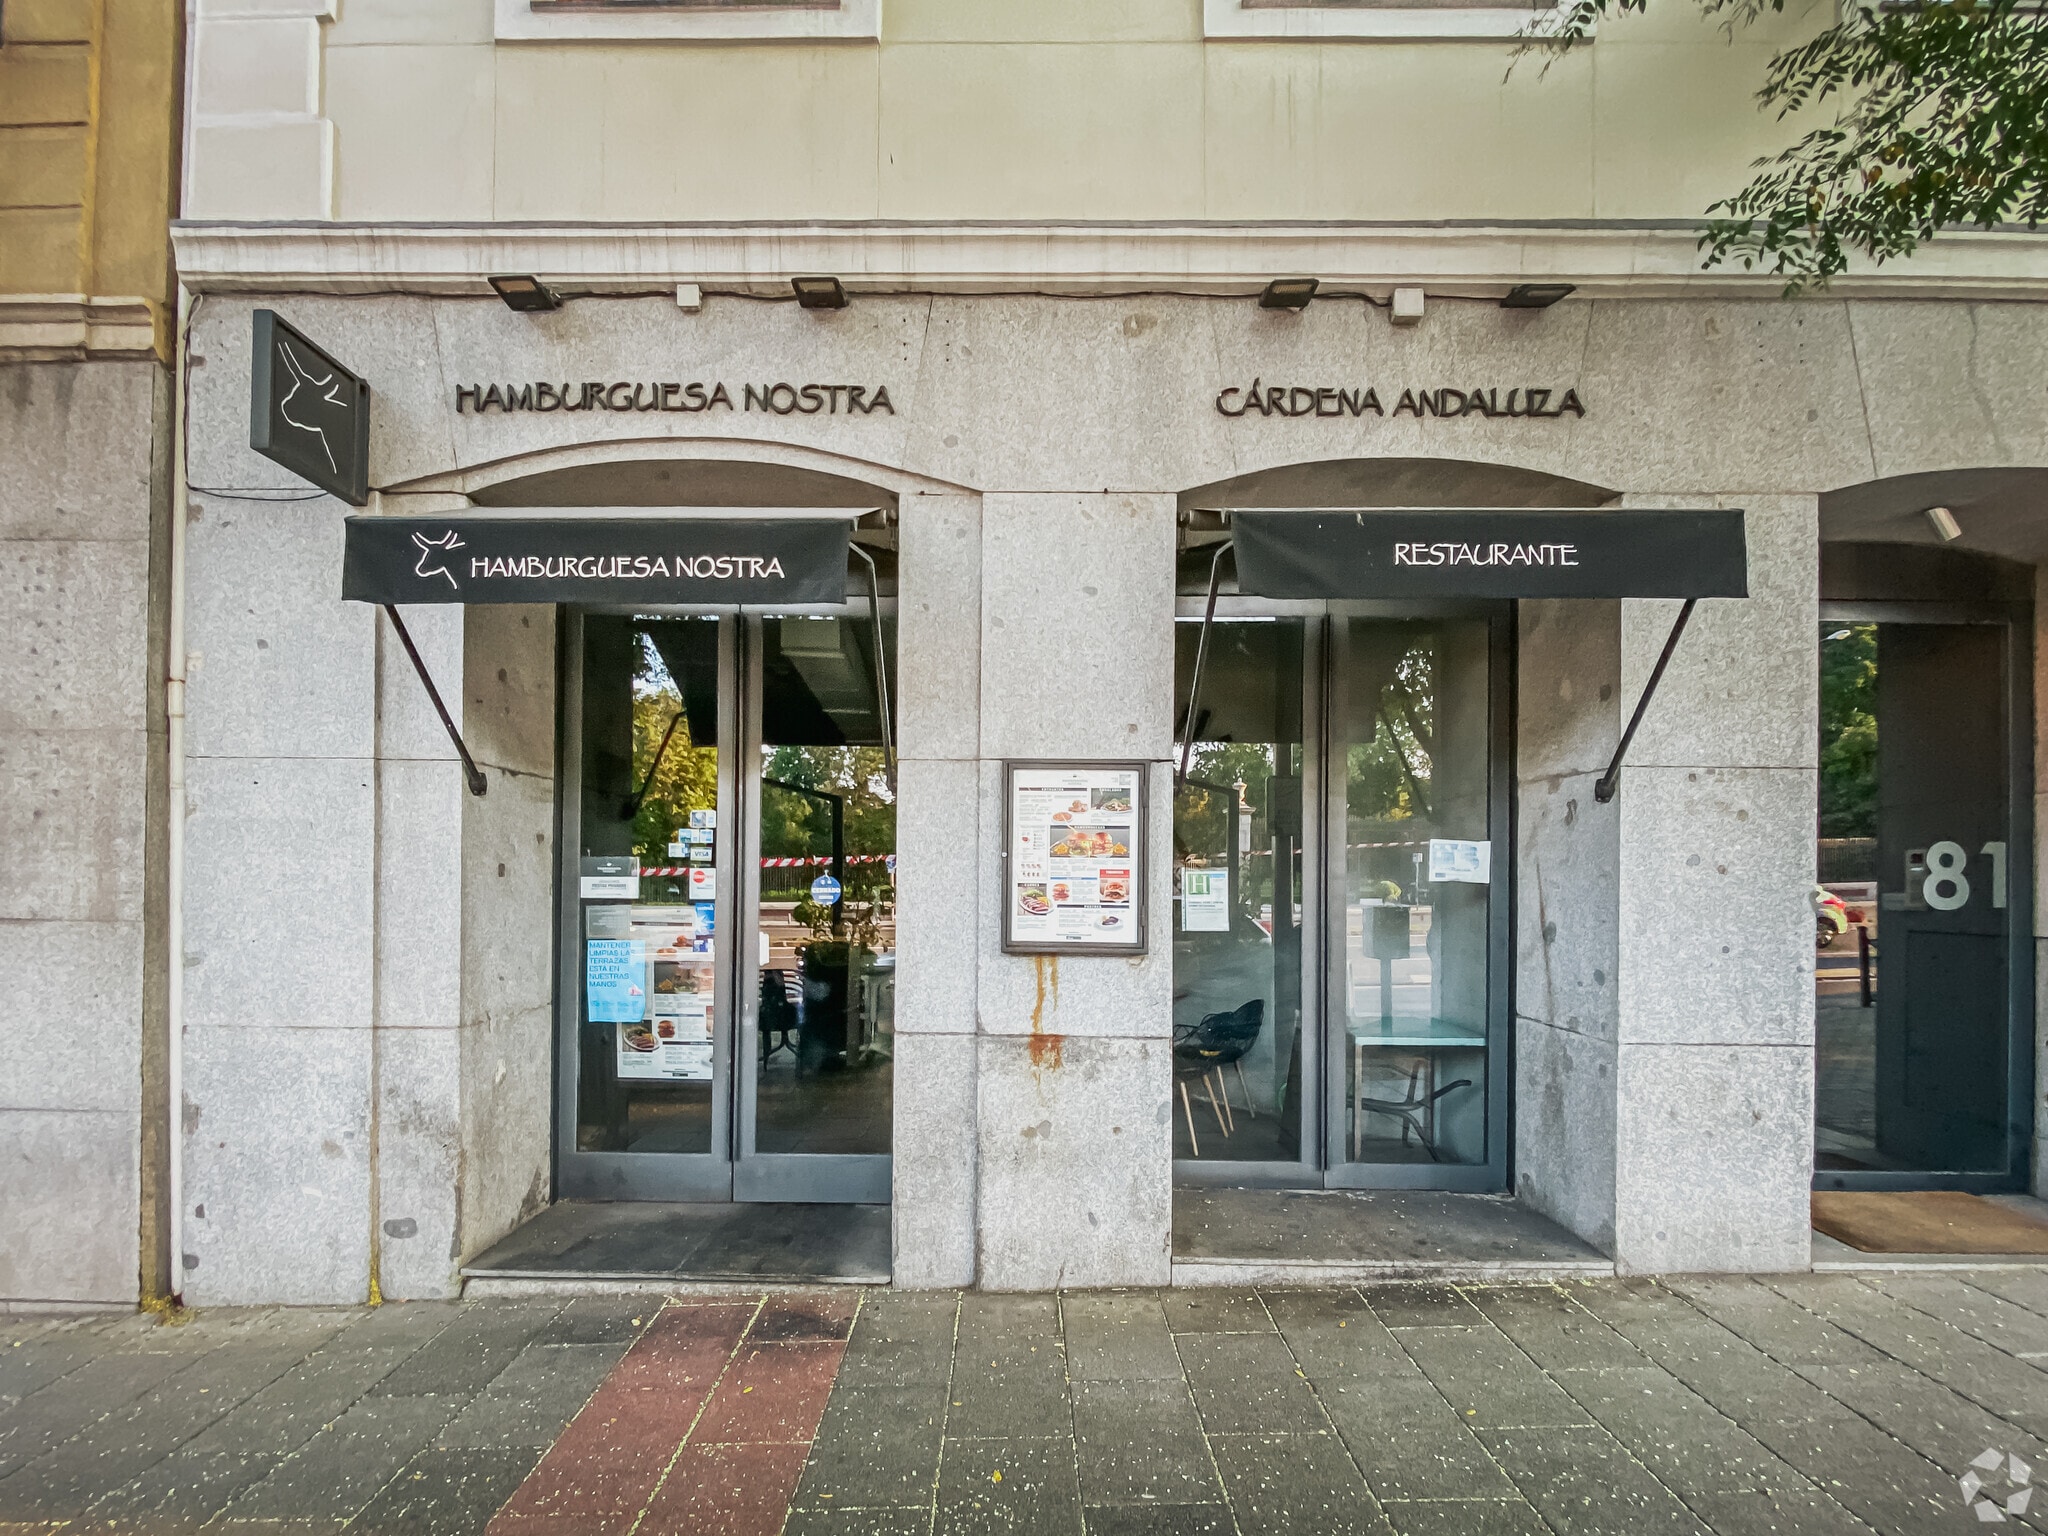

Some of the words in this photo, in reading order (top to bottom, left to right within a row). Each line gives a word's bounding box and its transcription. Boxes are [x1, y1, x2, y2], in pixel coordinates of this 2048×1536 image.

[455, 381, 734, 414] HAMBURGUESA
[744, 382, 895, 415] NOSTRA
[1215, 377, 1384, 418] CÁRDENA
[1392, 386, 1586, 419] ANDALUZA
[1394, 543, 1579, 566] RESTAURANTE
[470, 556, 670, 579] HAMBURGUESA
[675, 556, 786, 579] NOSTRA
[1190, 875, 1209, 894] H
[1922, 840, 2007, 911] 81
[589, 949, 619, 957] LIMPIAS
[589, 980, 617, 988] MANOS
